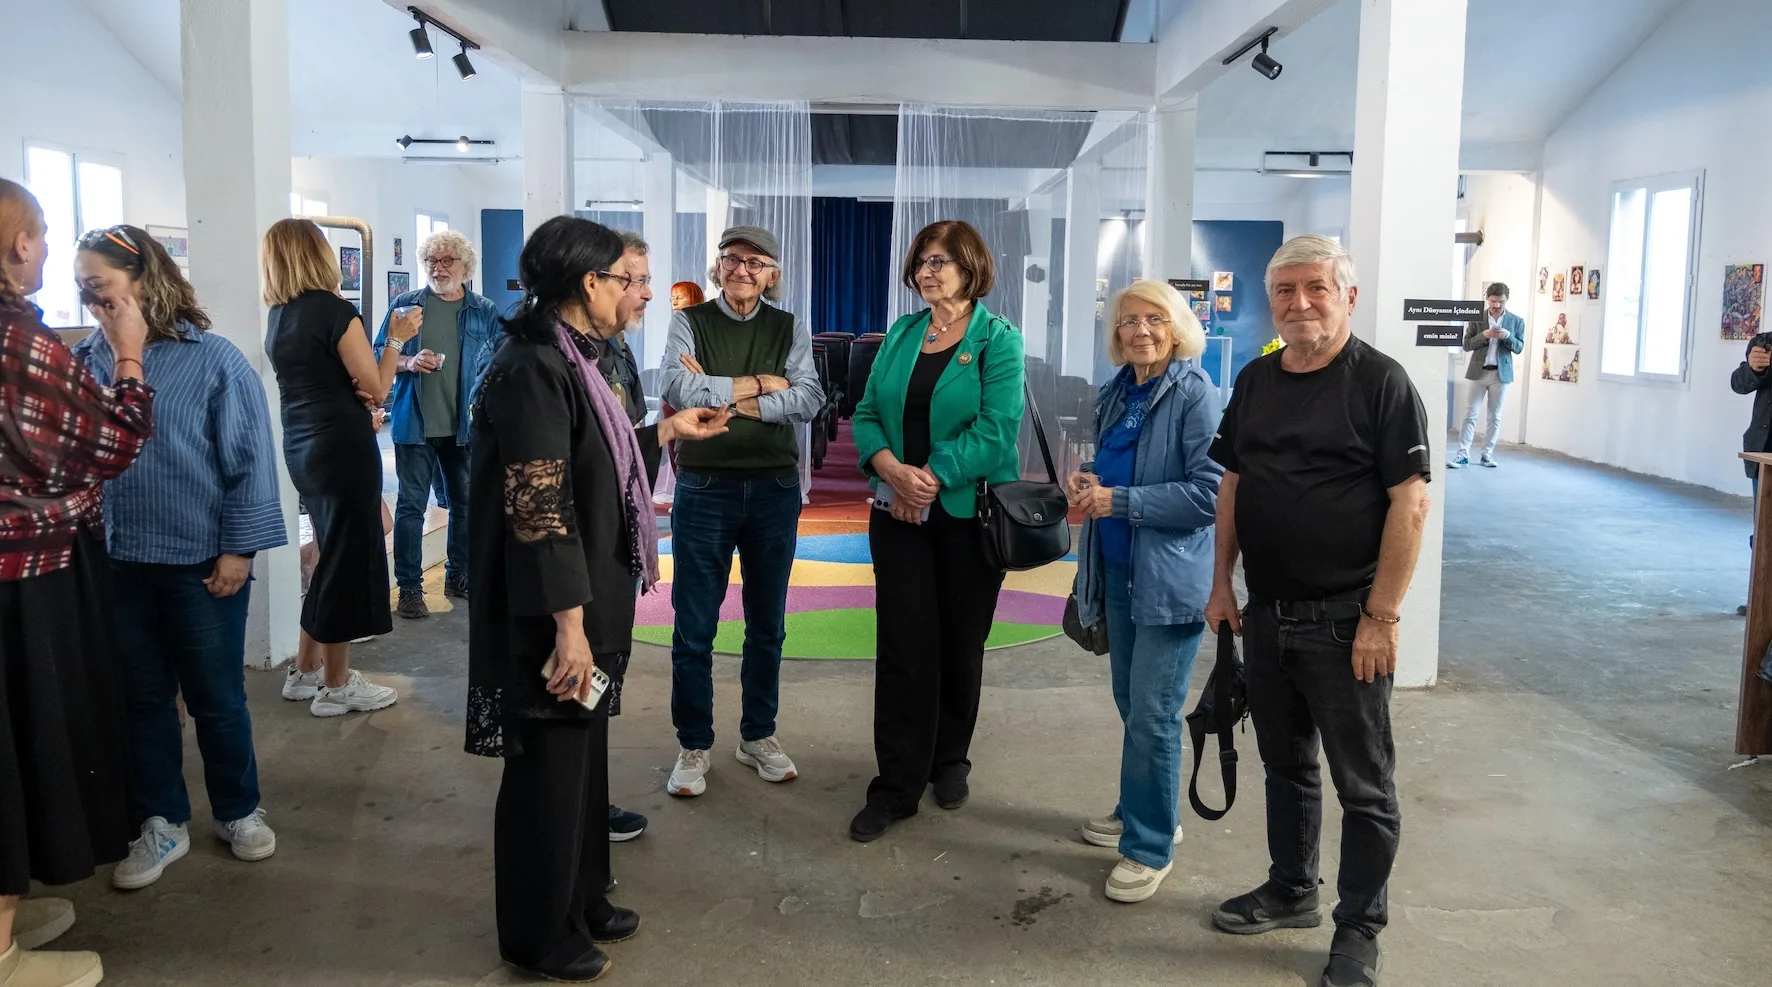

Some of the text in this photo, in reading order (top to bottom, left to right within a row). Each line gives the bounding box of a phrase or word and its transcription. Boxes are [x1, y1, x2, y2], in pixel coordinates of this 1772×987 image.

[1408, 306, 1480, 315] Aynı Dünyanın İçindesin
[1439, 332, 1458, 340] misin?
